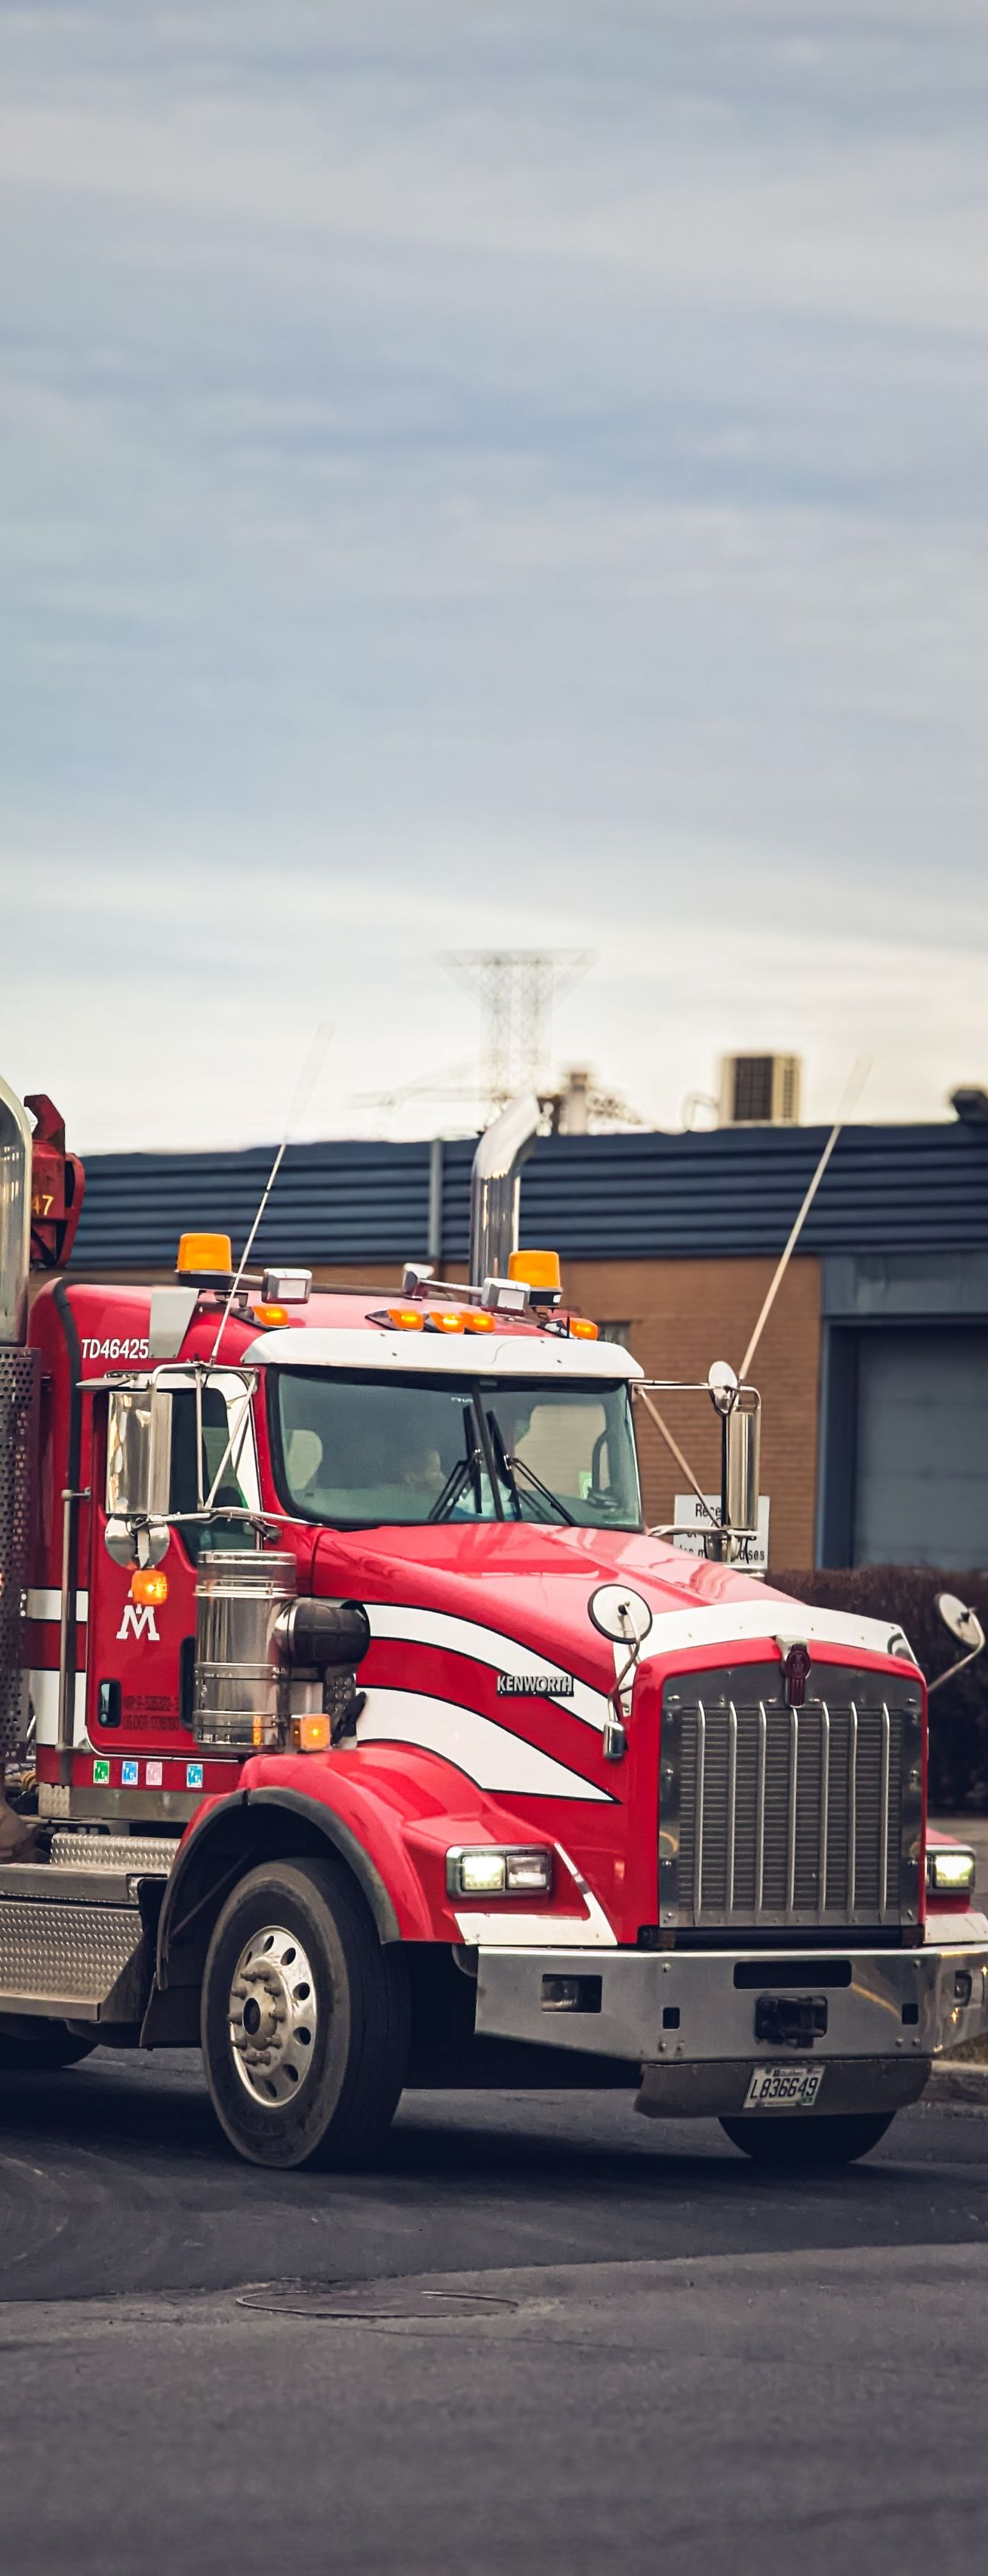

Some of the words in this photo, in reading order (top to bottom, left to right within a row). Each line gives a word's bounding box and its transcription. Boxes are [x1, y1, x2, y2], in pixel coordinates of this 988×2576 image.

[81, 1338, 149, 1359] TD46425
[497, 1675, 573, 1692] KENWORTH
[750, 2077, 819, 2099] L836649
